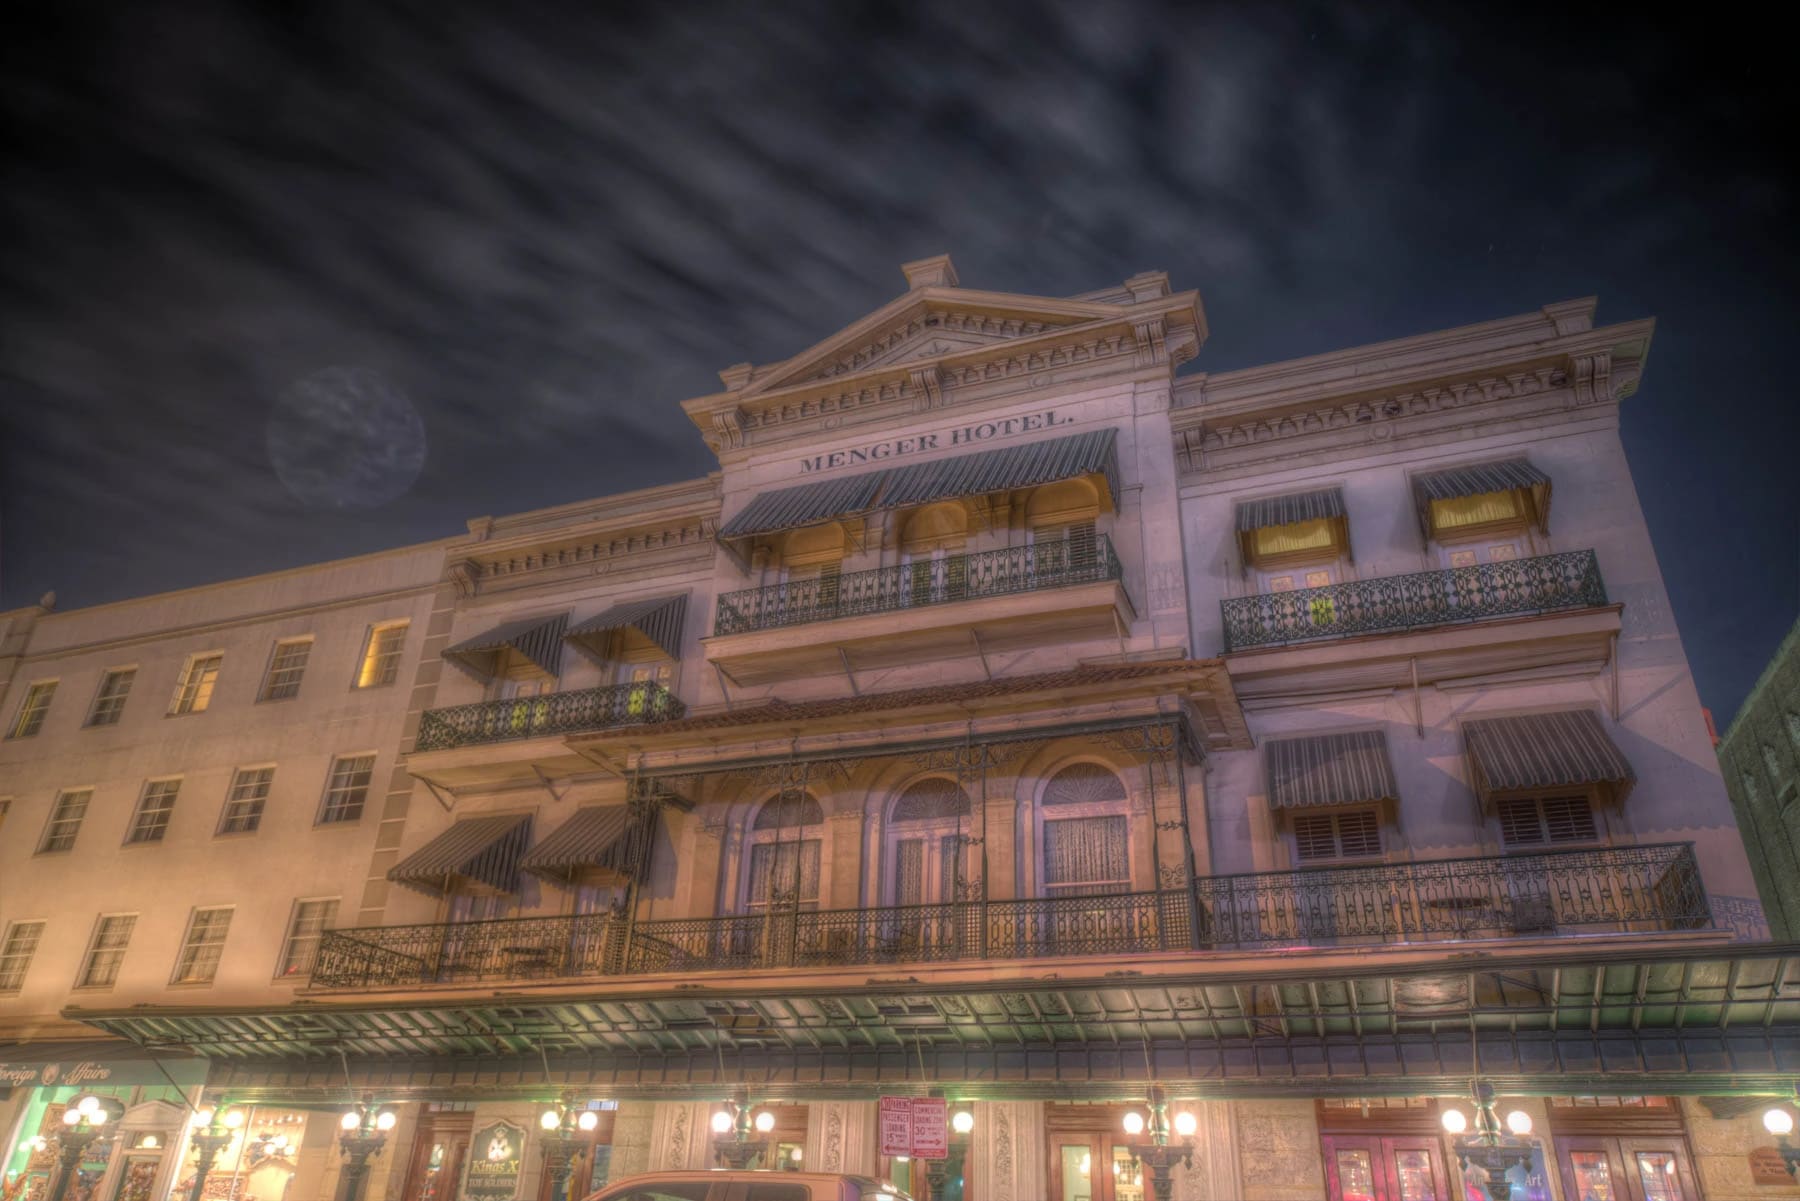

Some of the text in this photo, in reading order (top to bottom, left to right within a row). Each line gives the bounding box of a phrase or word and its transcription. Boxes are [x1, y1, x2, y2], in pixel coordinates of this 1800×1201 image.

[799, 433, 939, 474] MENGER
[915, 1126, 926, 1136] 30
[471, 1160, 520, 1175] Kings X
[1525, 1173, 1543, 1187] Art
